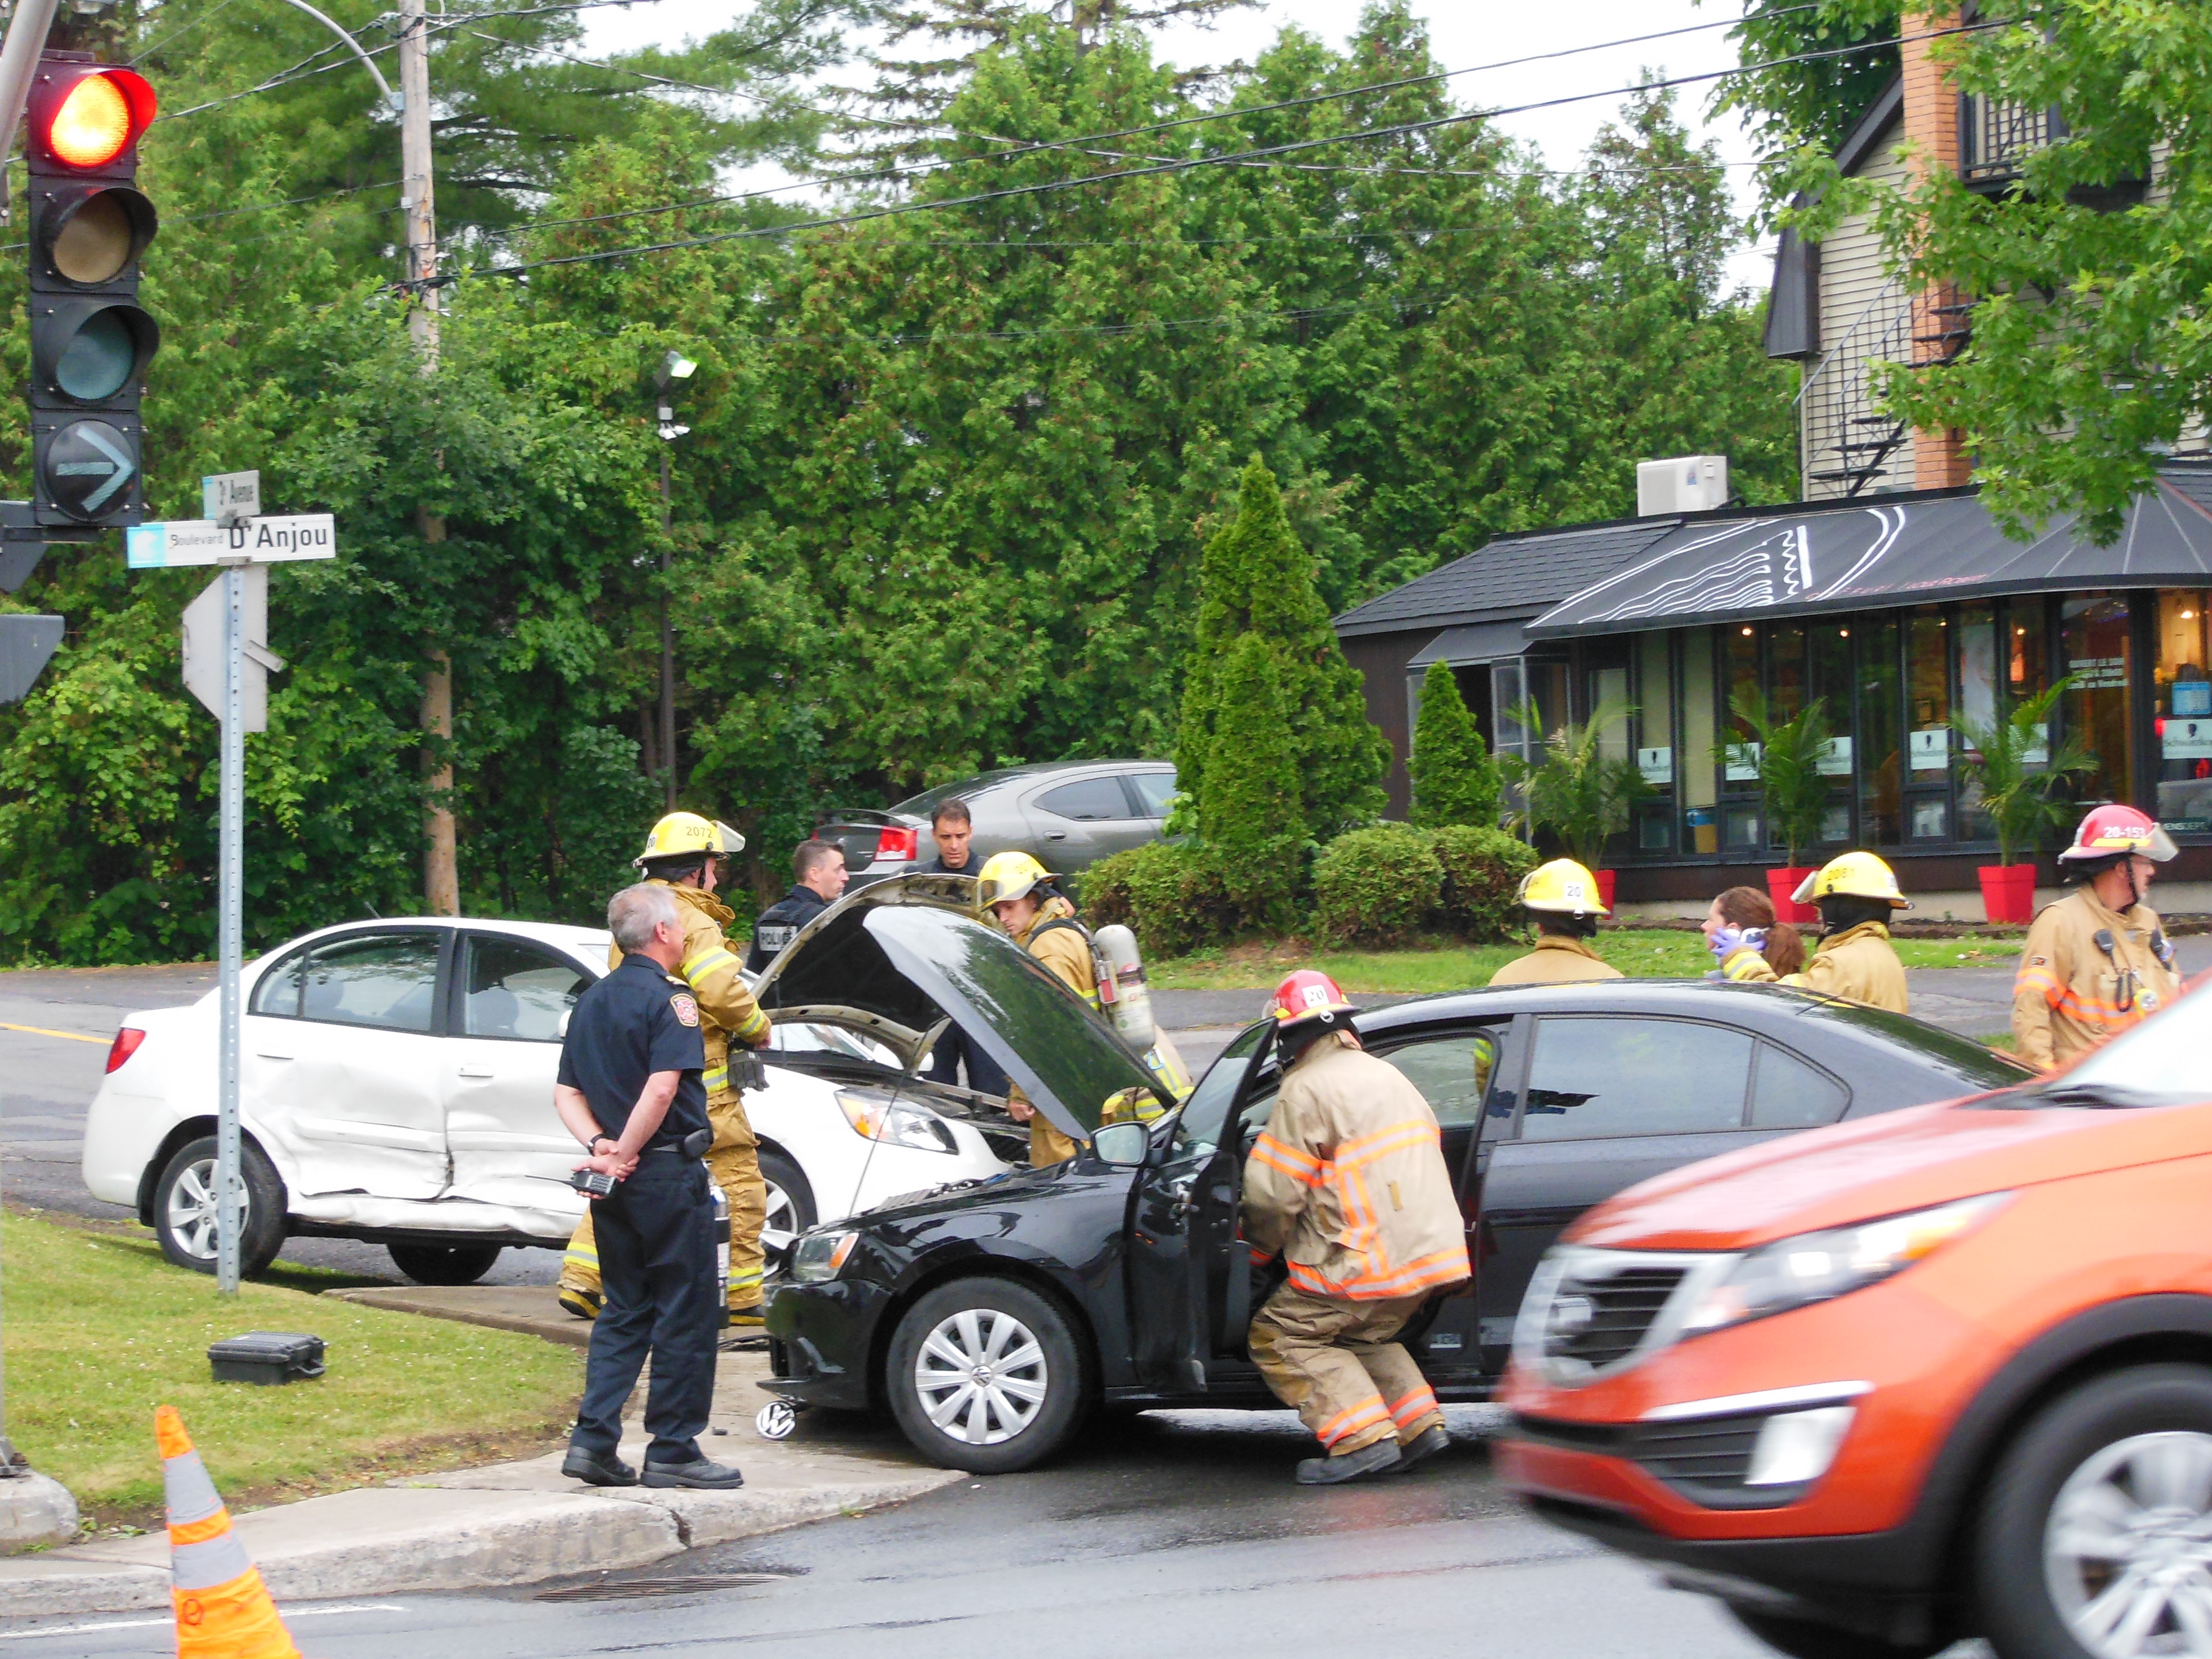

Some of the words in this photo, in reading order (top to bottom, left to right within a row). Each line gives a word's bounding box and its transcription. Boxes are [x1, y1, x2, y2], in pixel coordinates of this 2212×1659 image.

[170, 531, 223, 546] Boulevard
[230, 522, 326, 553] D'Anjou
[685, 827, 713, 838] 2072
[1567, 886, 1581, 897] 20
[1310, 989, 1324, 1001] 20
